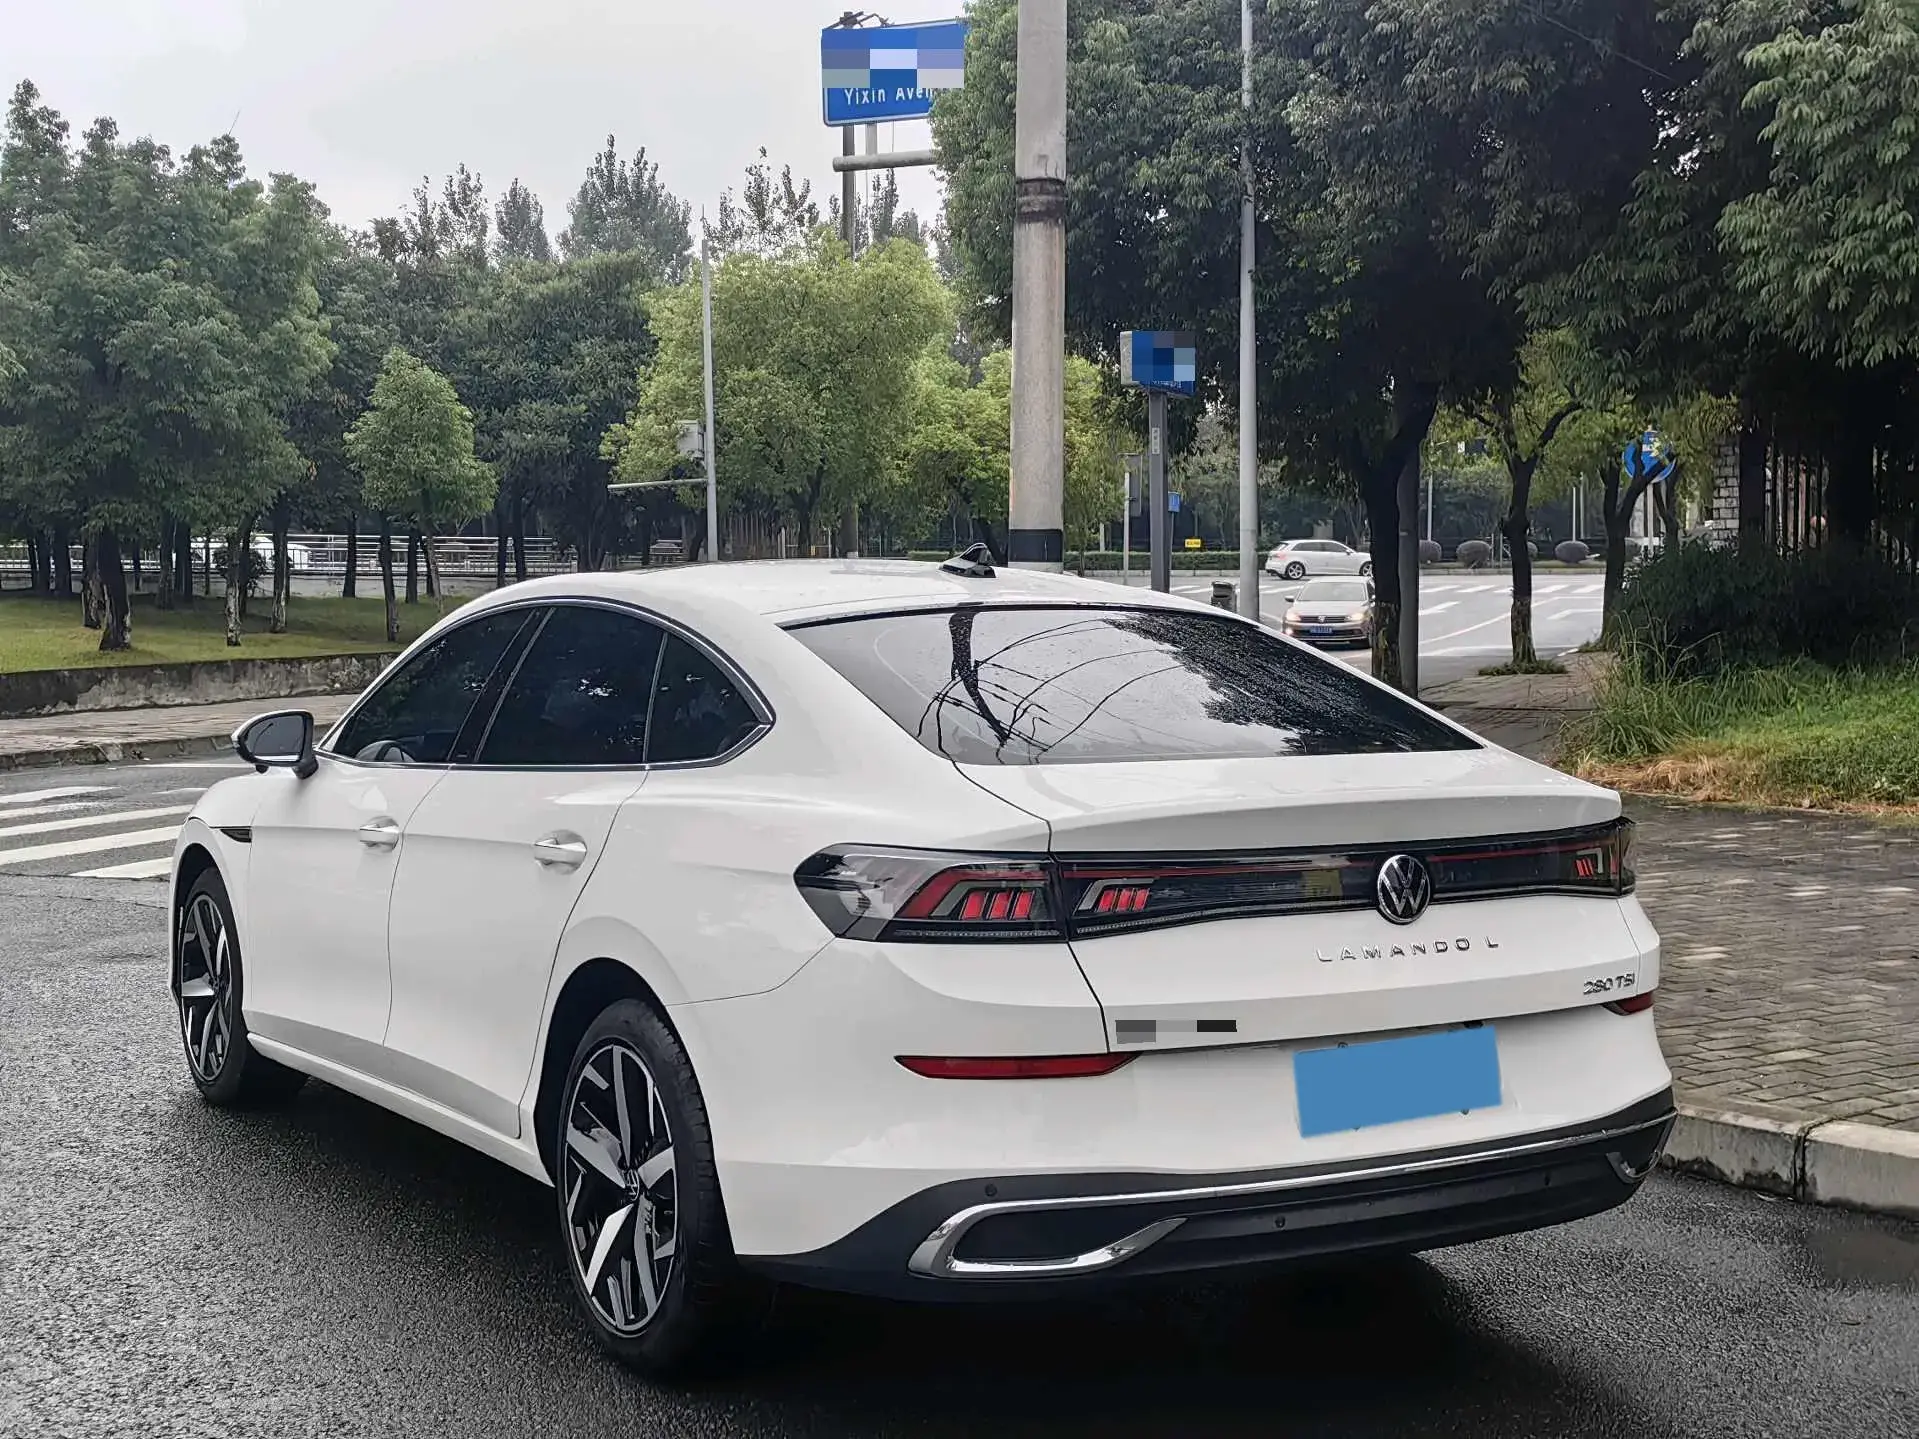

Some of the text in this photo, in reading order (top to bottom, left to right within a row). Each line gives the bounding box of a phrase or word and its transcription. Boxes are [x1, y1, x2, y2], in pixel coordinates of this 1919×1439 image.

[844, 87, 934, 105] Yixin Aven
[1315, 935, 1499, 962] LAMANDO L
[1583, 972, 1635, 995] 280 TSI
